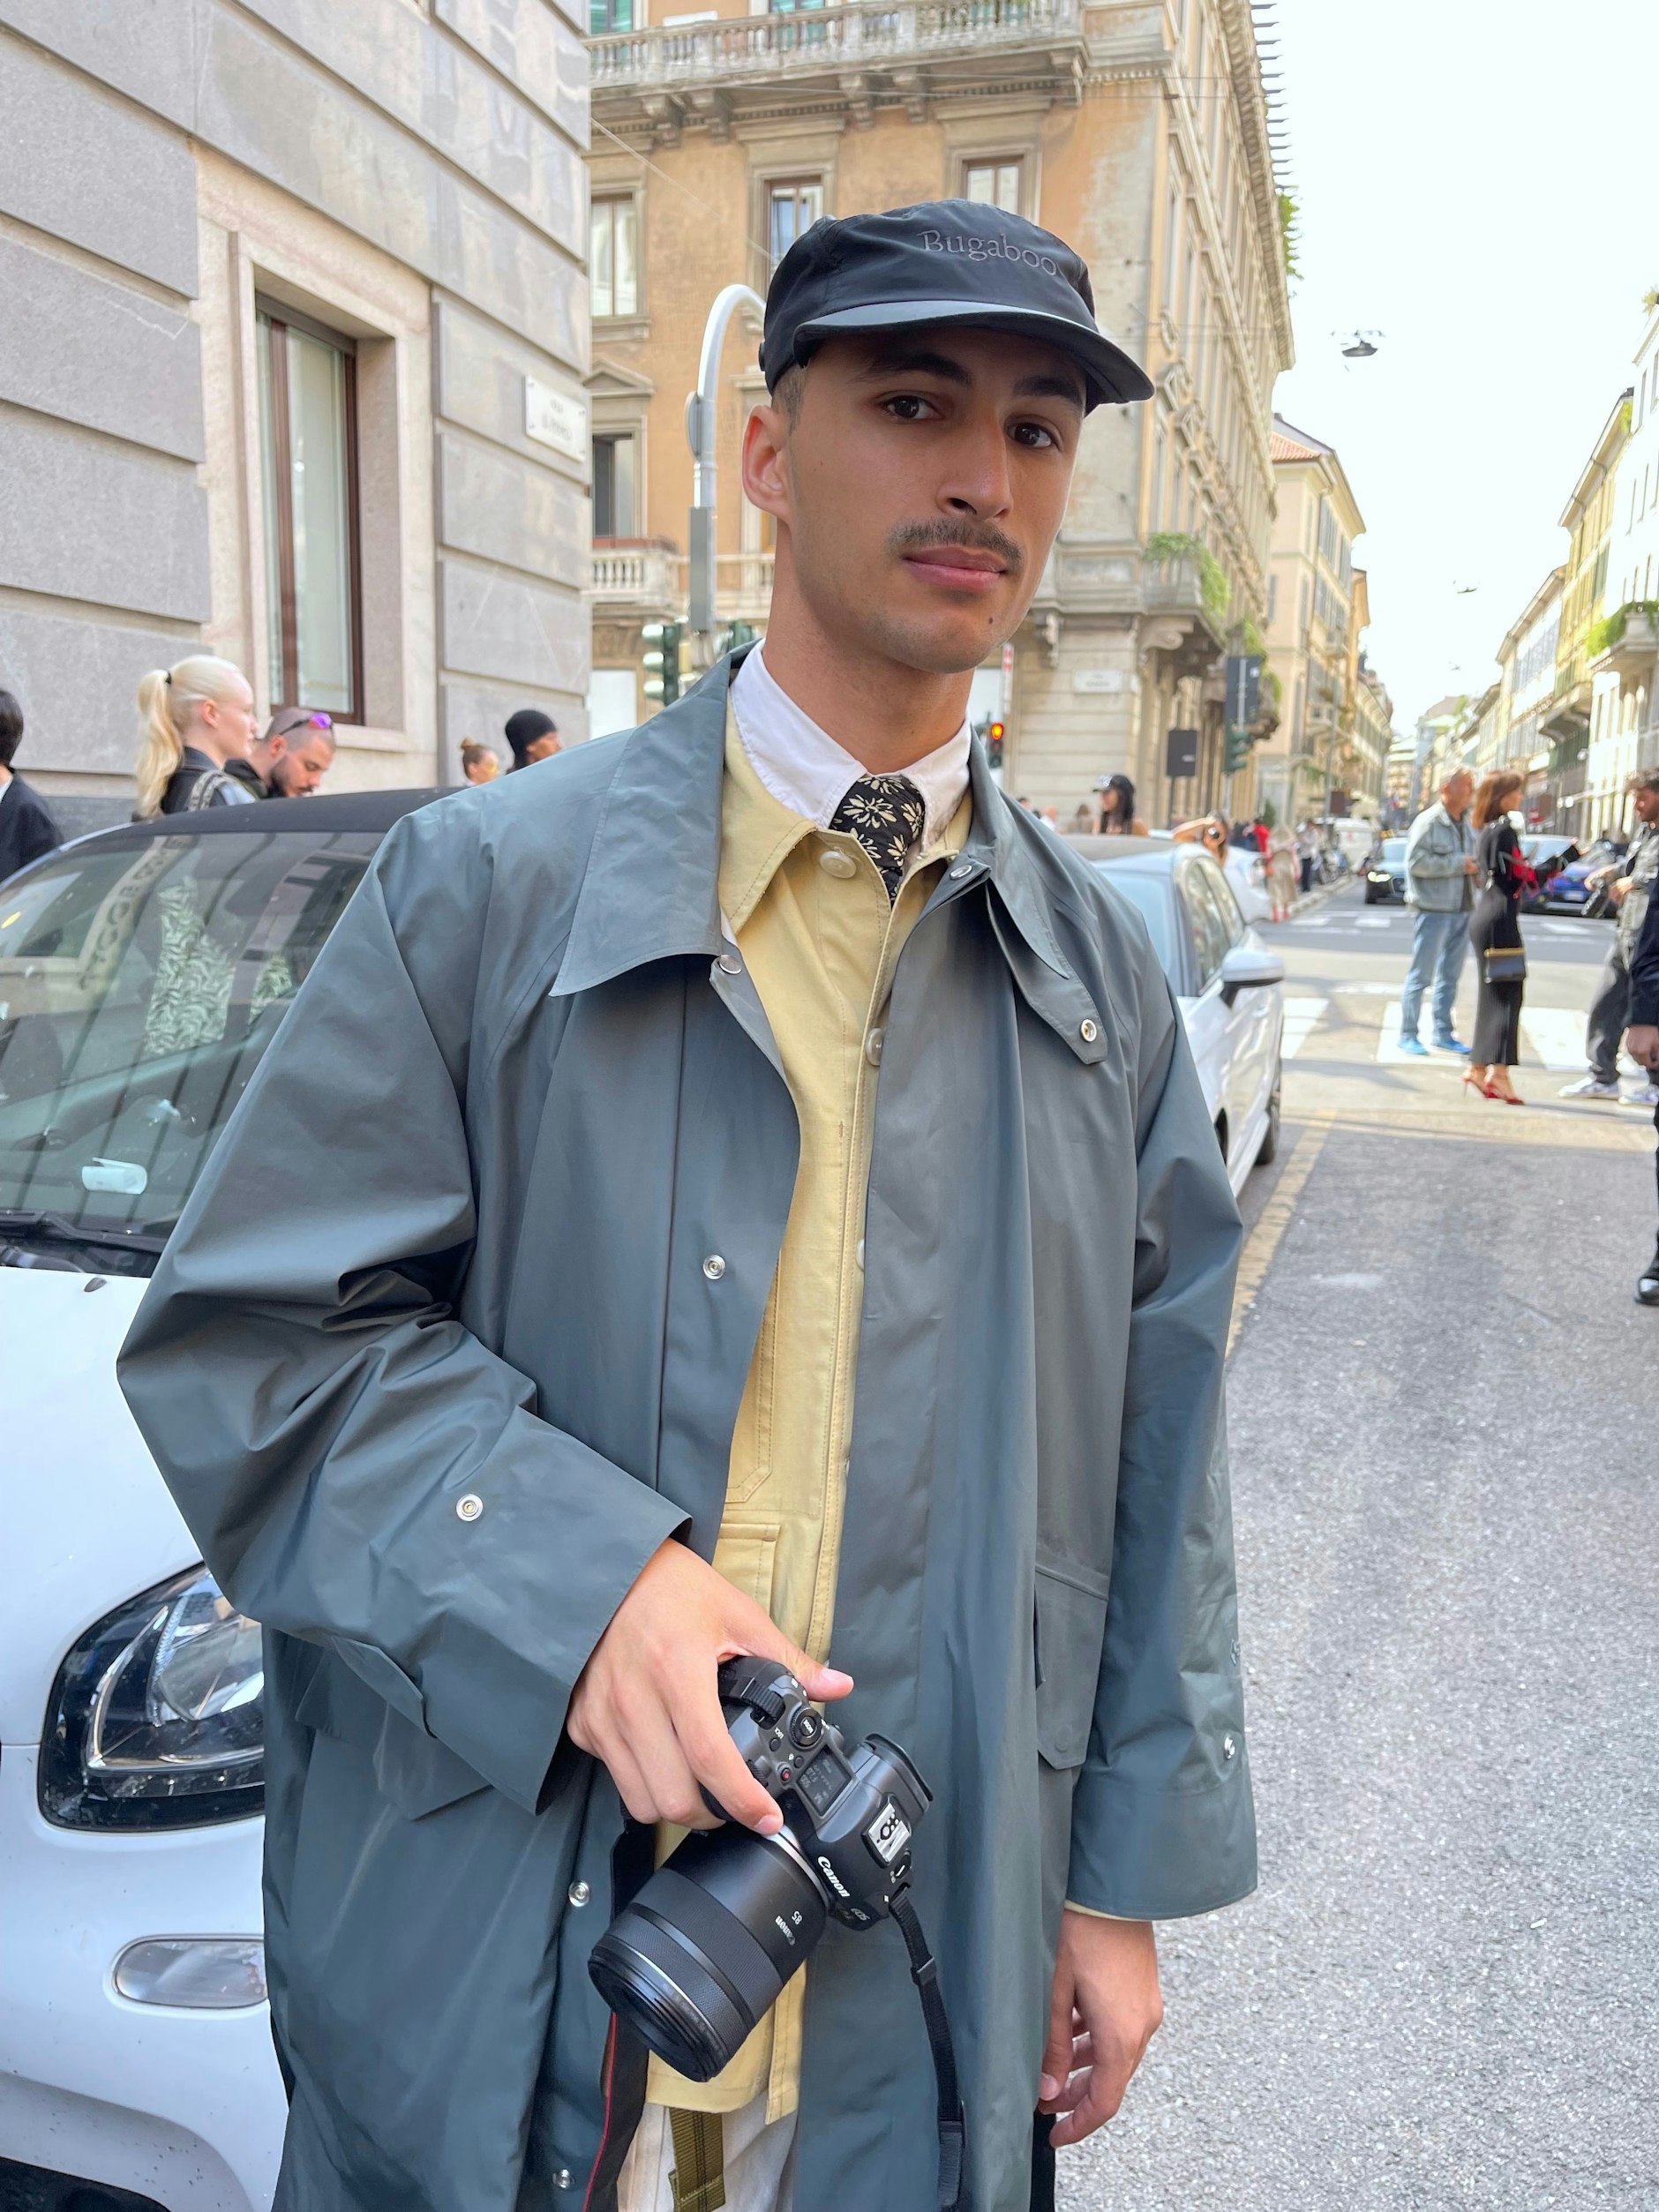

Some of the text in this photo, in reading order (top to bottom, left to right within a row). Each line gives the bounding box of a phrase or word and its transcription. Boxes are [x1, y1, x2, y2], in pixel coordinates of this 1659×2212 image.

[917, 229, 1057, 276] Bugaboo
[817, 1856, 850, 1897] Canon
[775, 1915, 796, 1946] Canon
[791, 1910, 802, 1925] 85
